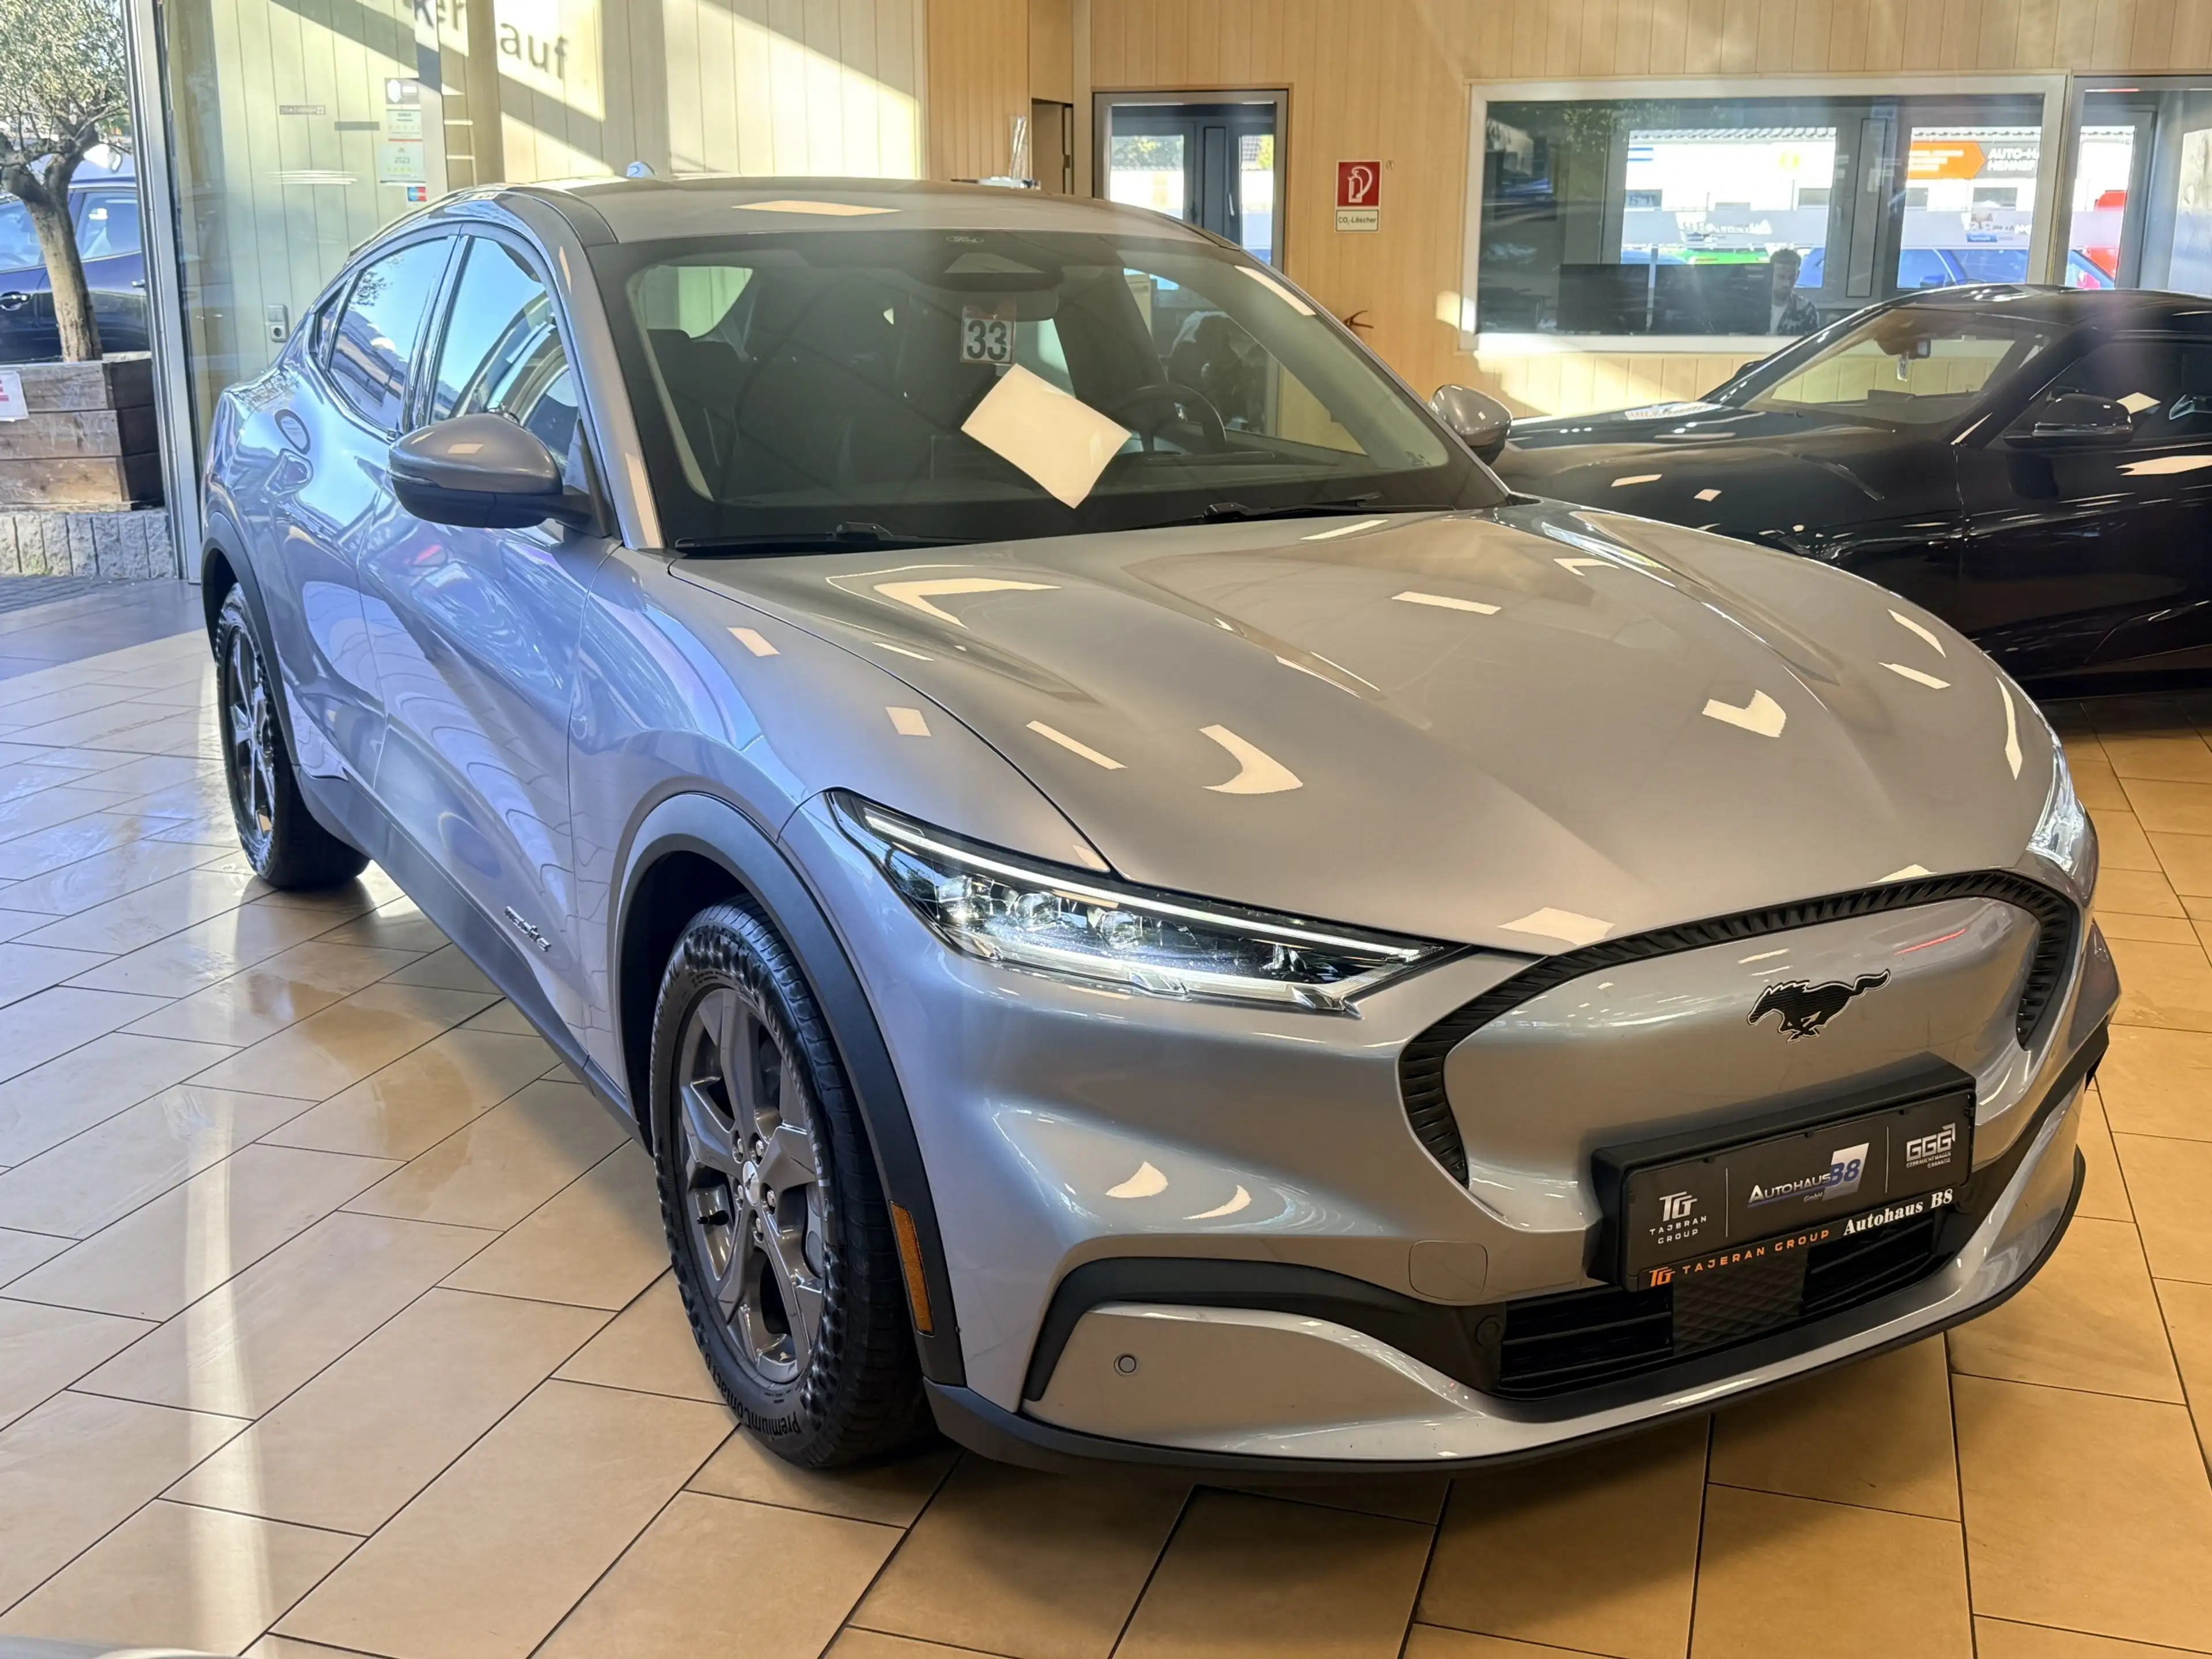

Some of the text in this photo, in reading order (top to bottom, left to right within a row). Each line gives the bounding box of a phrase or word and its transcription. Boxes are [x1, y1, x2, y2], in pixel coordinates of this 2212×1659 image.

[499, 22, 570, 79] auf
[966, 319, 1007, 361] 33
[1906, 1130, 1952, 1162] GGG
[1906, 1151, 1952, 1169] GEBRAUCHTWAGEN
[1829, 1158, 1861, 1187] B8
[1927, 1157, 1952, 1169] GARANTIE
[1803, 1191, 1823, 1203] GmbH
[1649, 1215, 1707, 1236] TAJERAN
[1843, 1188, 1953, 1236] Autohaus B8
[1657, 1228, 1699, 1244] GROUP
[1682, 1246, 1766, 1275] TAJERAN
[1774, 1229, 1830, 1252] GROUP
